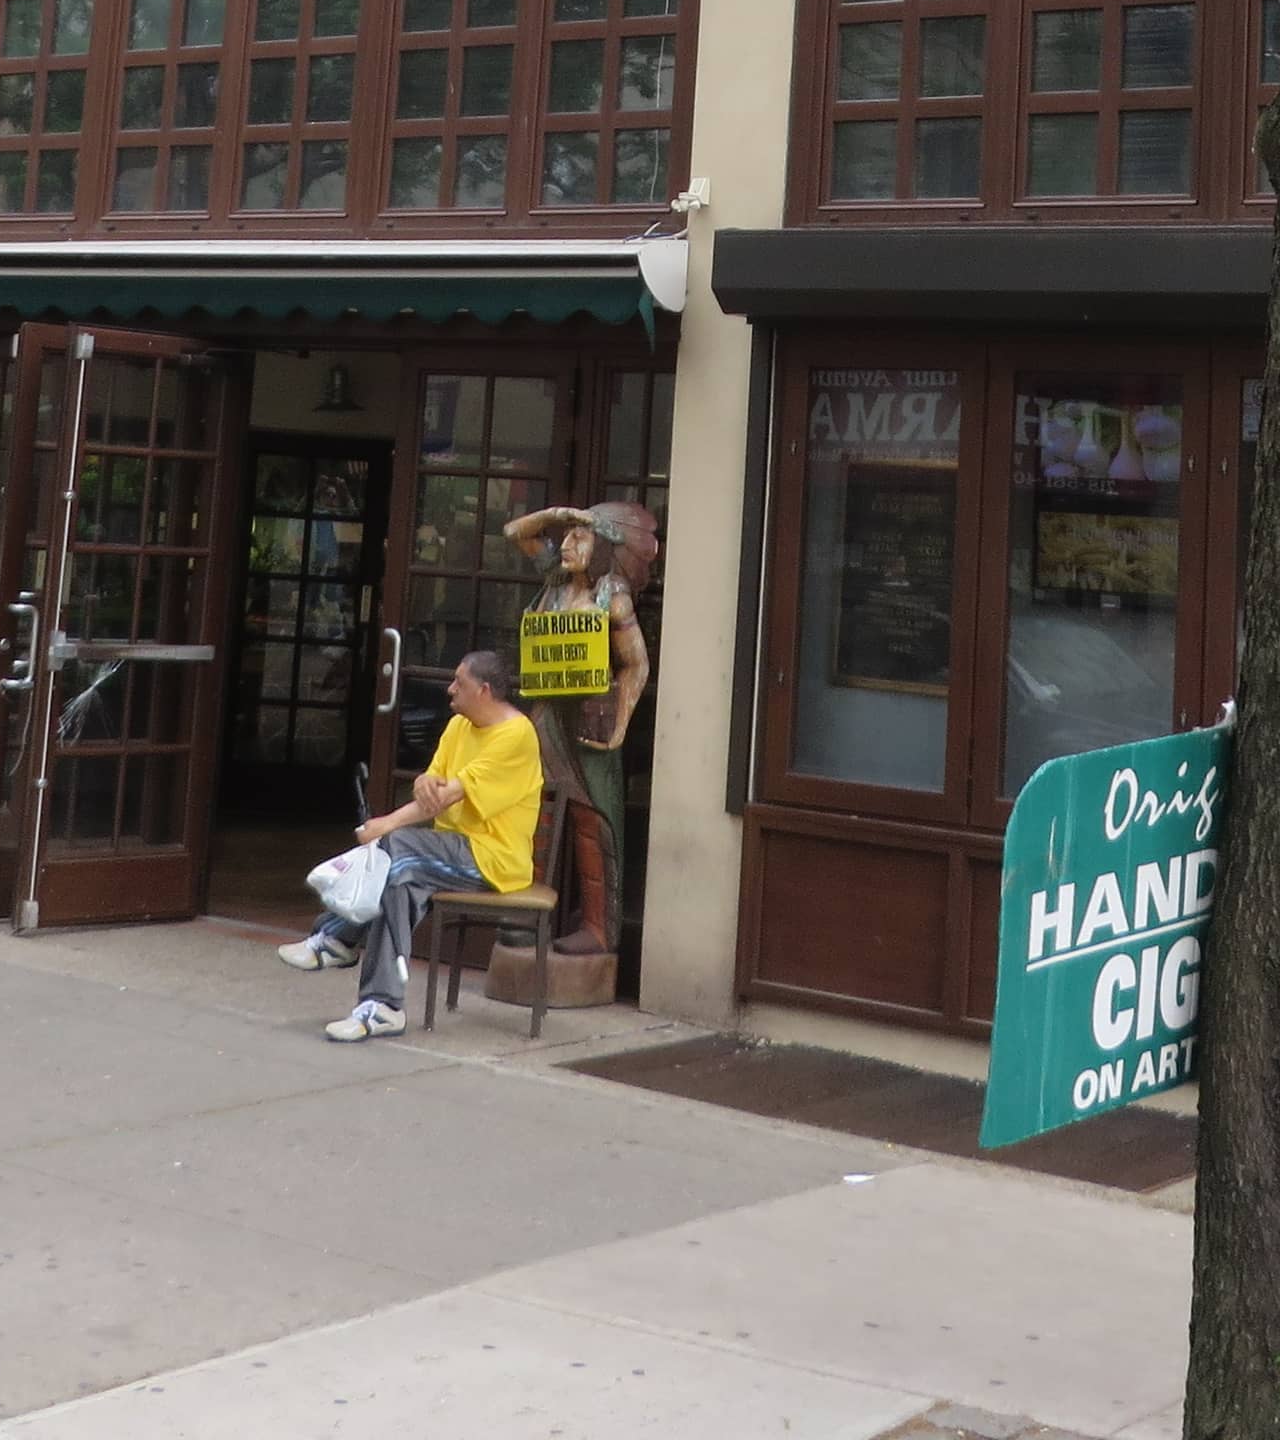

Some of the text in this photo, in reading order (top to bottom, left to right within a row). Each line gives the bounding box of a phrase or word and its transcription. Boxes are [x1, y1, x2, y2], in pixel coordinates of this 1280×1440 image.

[523, 613, 603, 637] CIGAR ROLLERS
[1104, 761, 1219, 841] Orig
[1028, 848, 1218, 960] HAND
[1093, 935, 1202, 1050] CIG
[1073, 1036, 1199, 1109] ON ART
